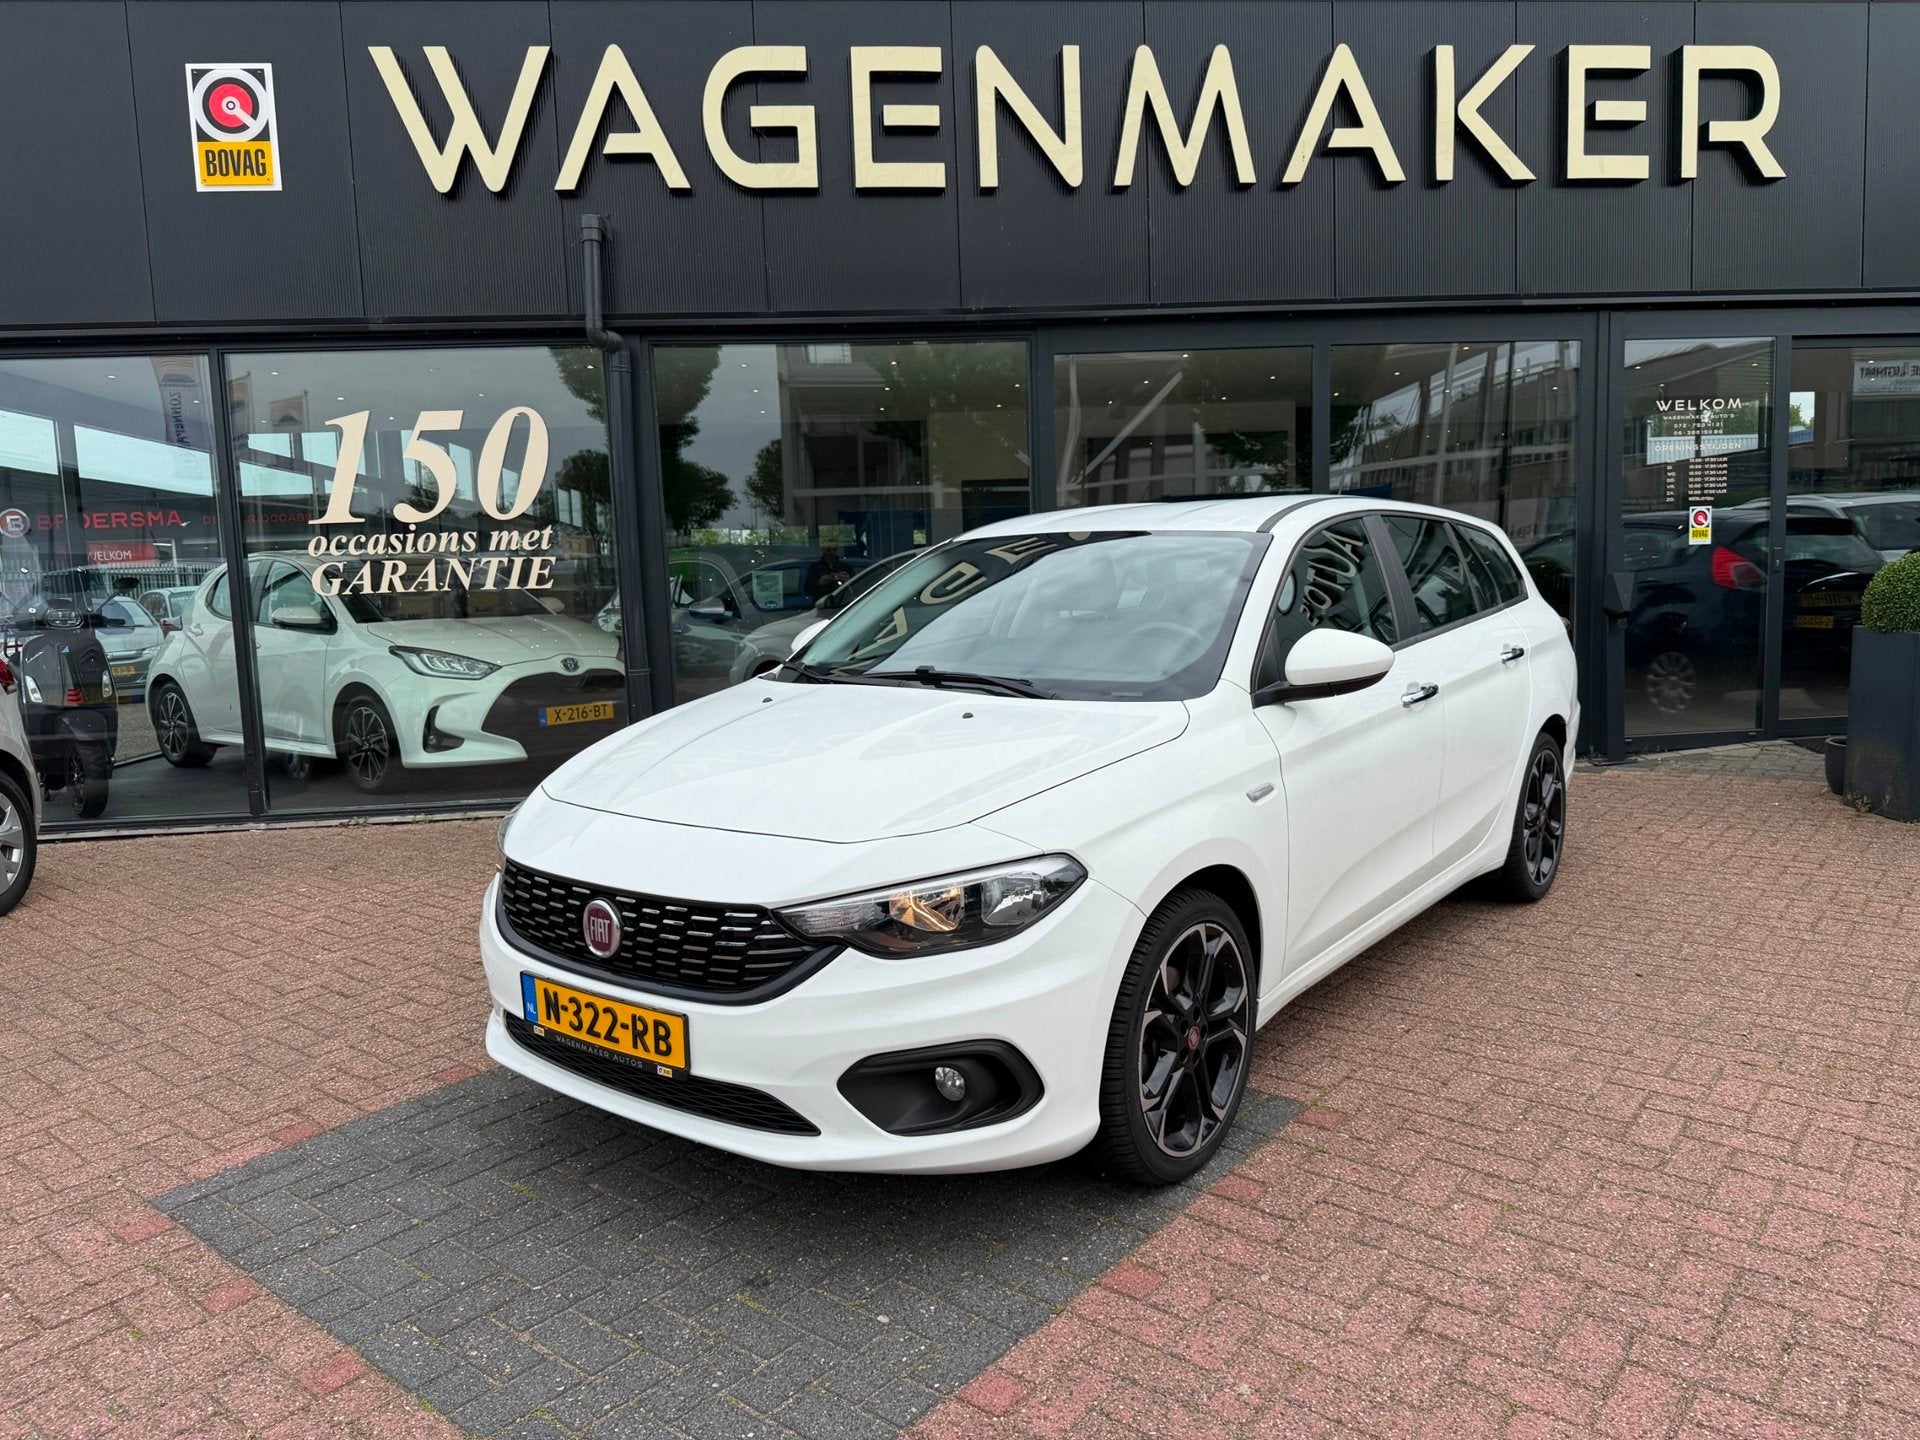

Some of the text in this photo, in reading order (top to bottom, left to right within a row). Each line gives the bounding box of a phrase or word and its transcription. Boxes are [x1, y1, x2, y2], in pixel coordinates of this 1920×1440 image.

[367, 43, 1788, 193] WAGENMAKER
[205, 148, 267, 178] BOVAG
[1656, 398, 1742, 412] WELKOM
[1655, 442, 1742, 452] OPENINGSTIJDEN
[308, 406, 549, 525] 150
[307, 523, 553, 557] occasions met
[1692, 529, 1709, 538] BOVAG
[311, 556, 557, 596] GARANTIE
[554, 703, 608, 722] X-216-BT
[590, 916, 610, 944] FIAT
[527, 986, 673, 1058] NL N-322-RB
[555, 1034, 644, 1069] WAGENMAKER AUTOS
